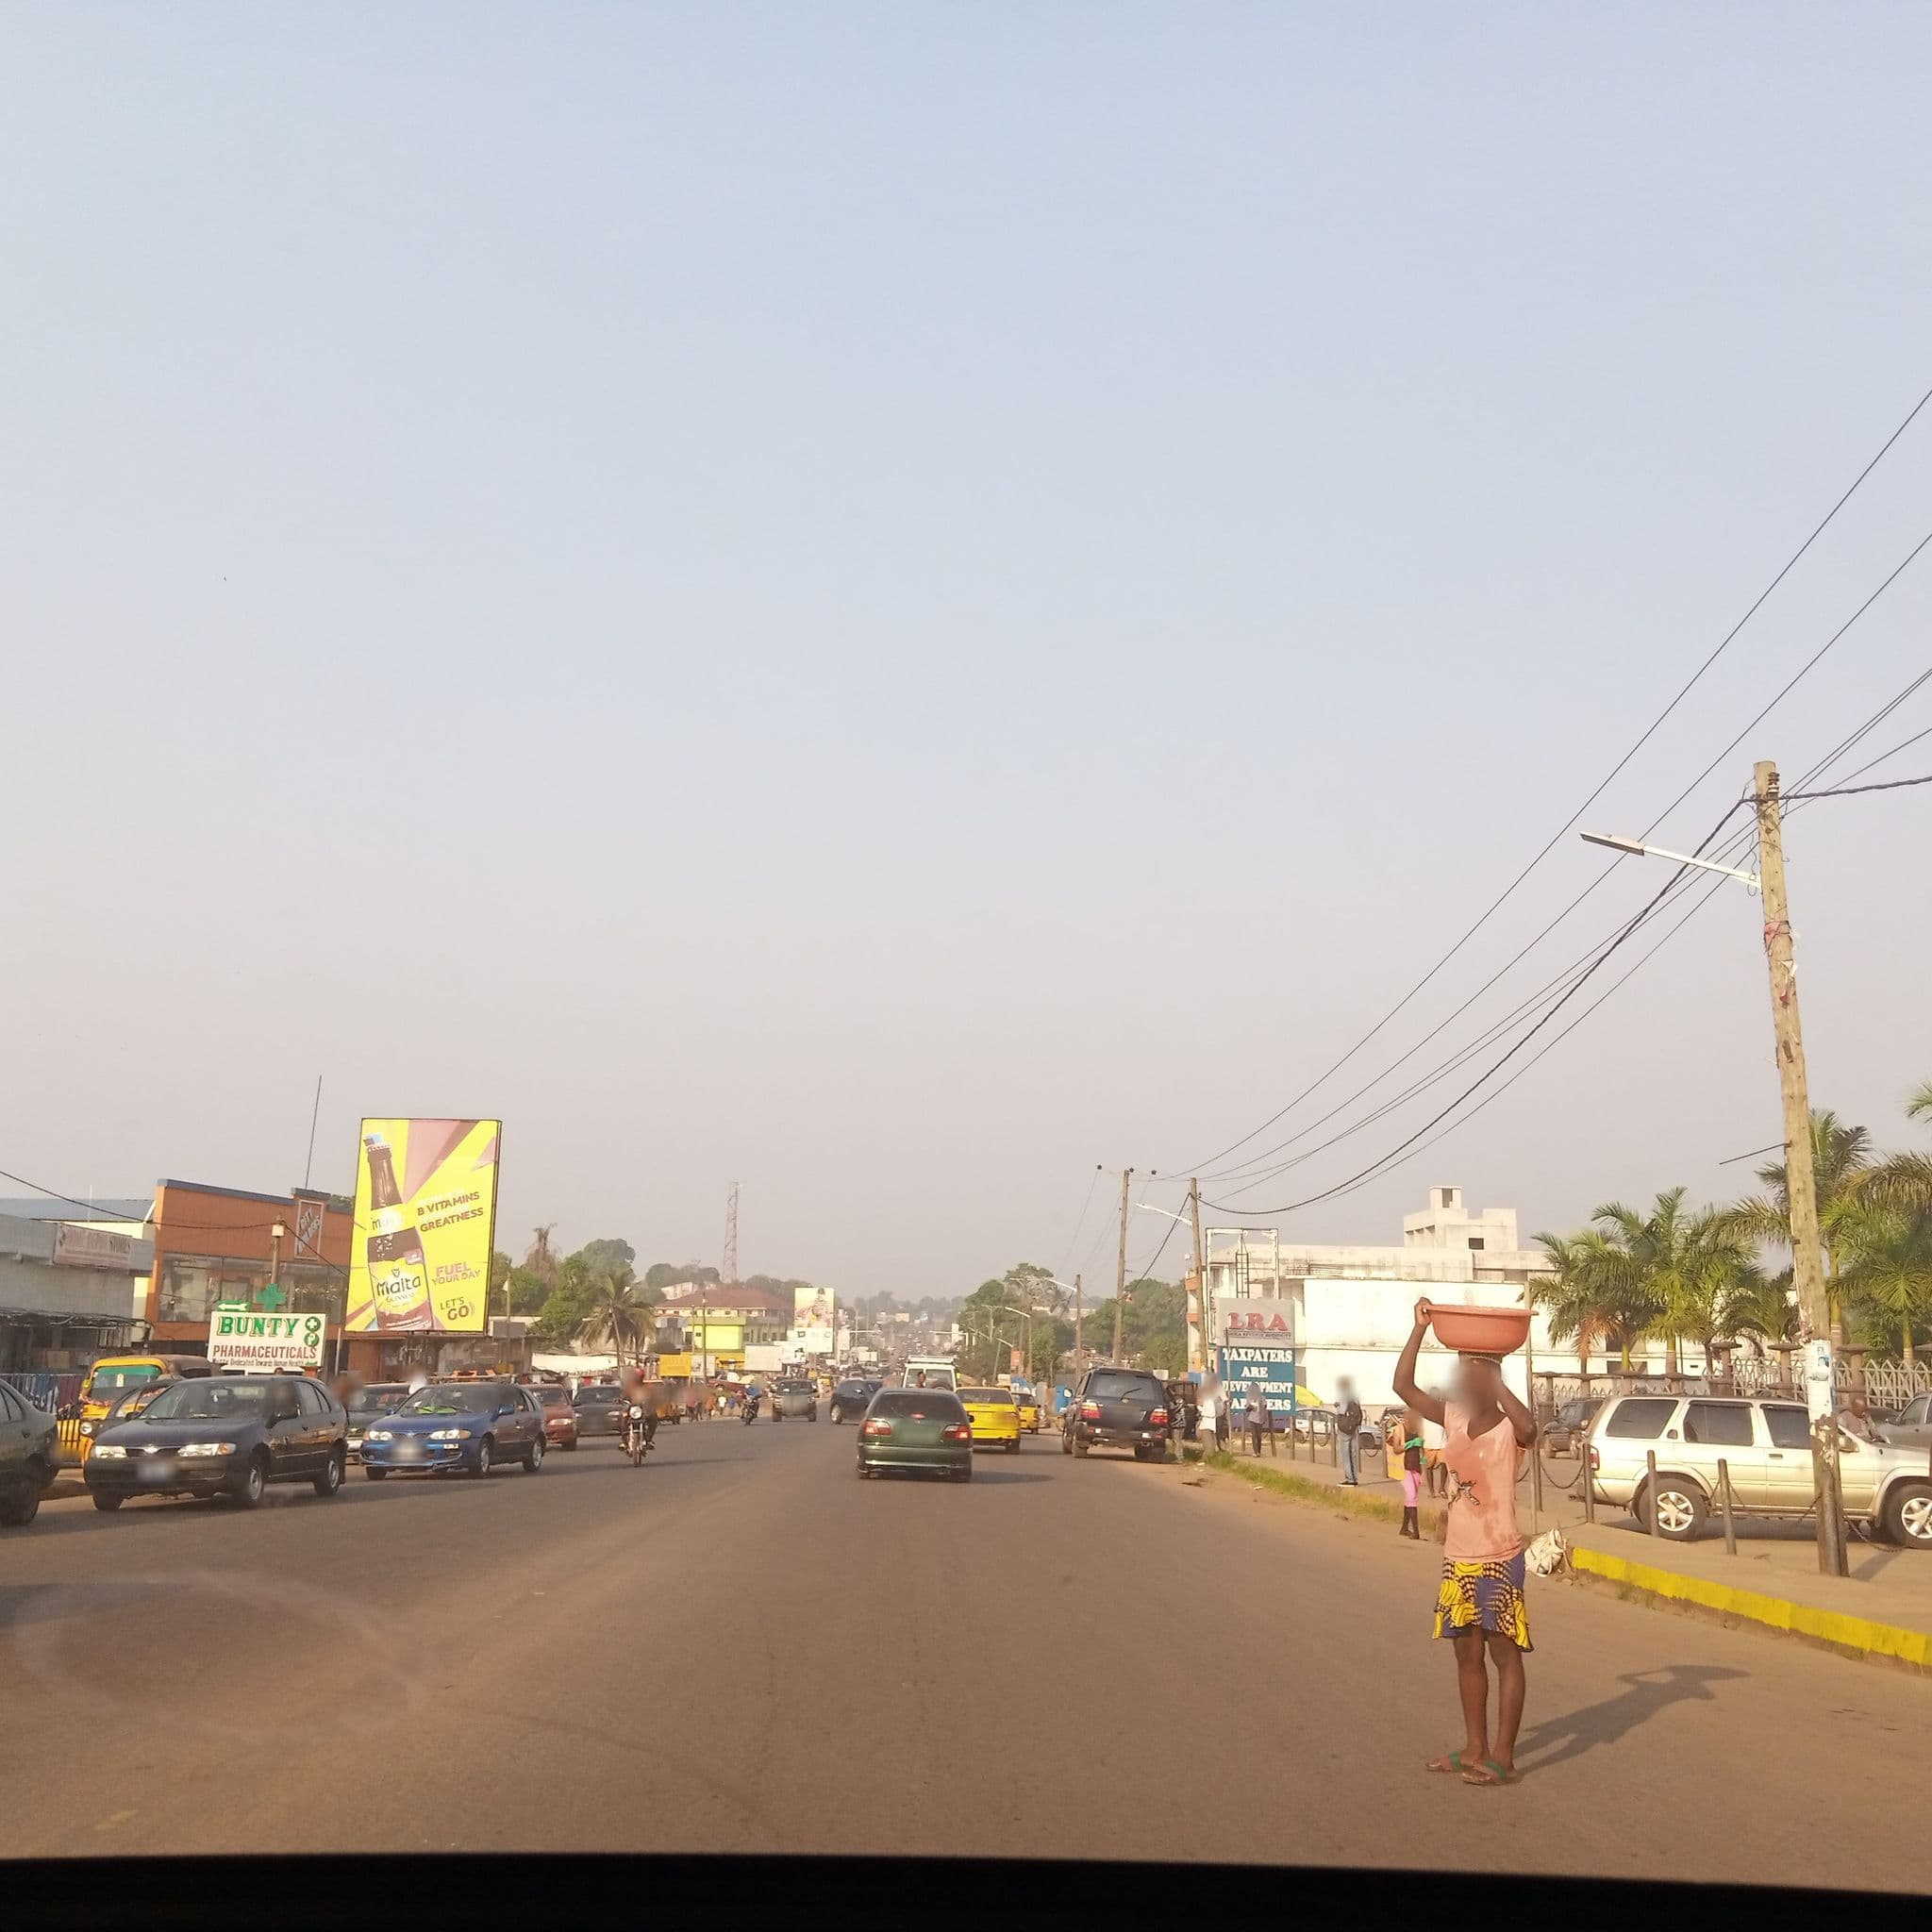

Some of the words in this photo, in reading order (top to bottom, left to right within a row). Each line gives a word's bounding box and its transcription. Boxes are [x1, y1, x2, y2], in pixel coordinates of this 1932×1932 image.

[417, 1207, 425, 1216] B
[427, 1191, 480, 1213] VITAMINS
[420, 1208, 484, 1232] GREATNESS
[436, 1261, 471, 1277] FUEL
[376, 1275, 422, 1297] Malta
[432, 1274, 458, 1287] YOUR
[461, 1269, 481, 1280] DAY
[440, 1297, 464, 1310] LET'S
[447, 1305, 470, 1321] GO
[217, 1316, 300, 1338] BUNTY
[1227, 1312, 1289, 1331] LRA
[212, 1345, 317, 1358] PHARMACEUTICALS
[1222, 1348, 1292, 1362] TAXPAYERS
[1241, 1366, 1268, 1377] ARE
[1222, 1380, 1292, 1393] DEVEPMENT
